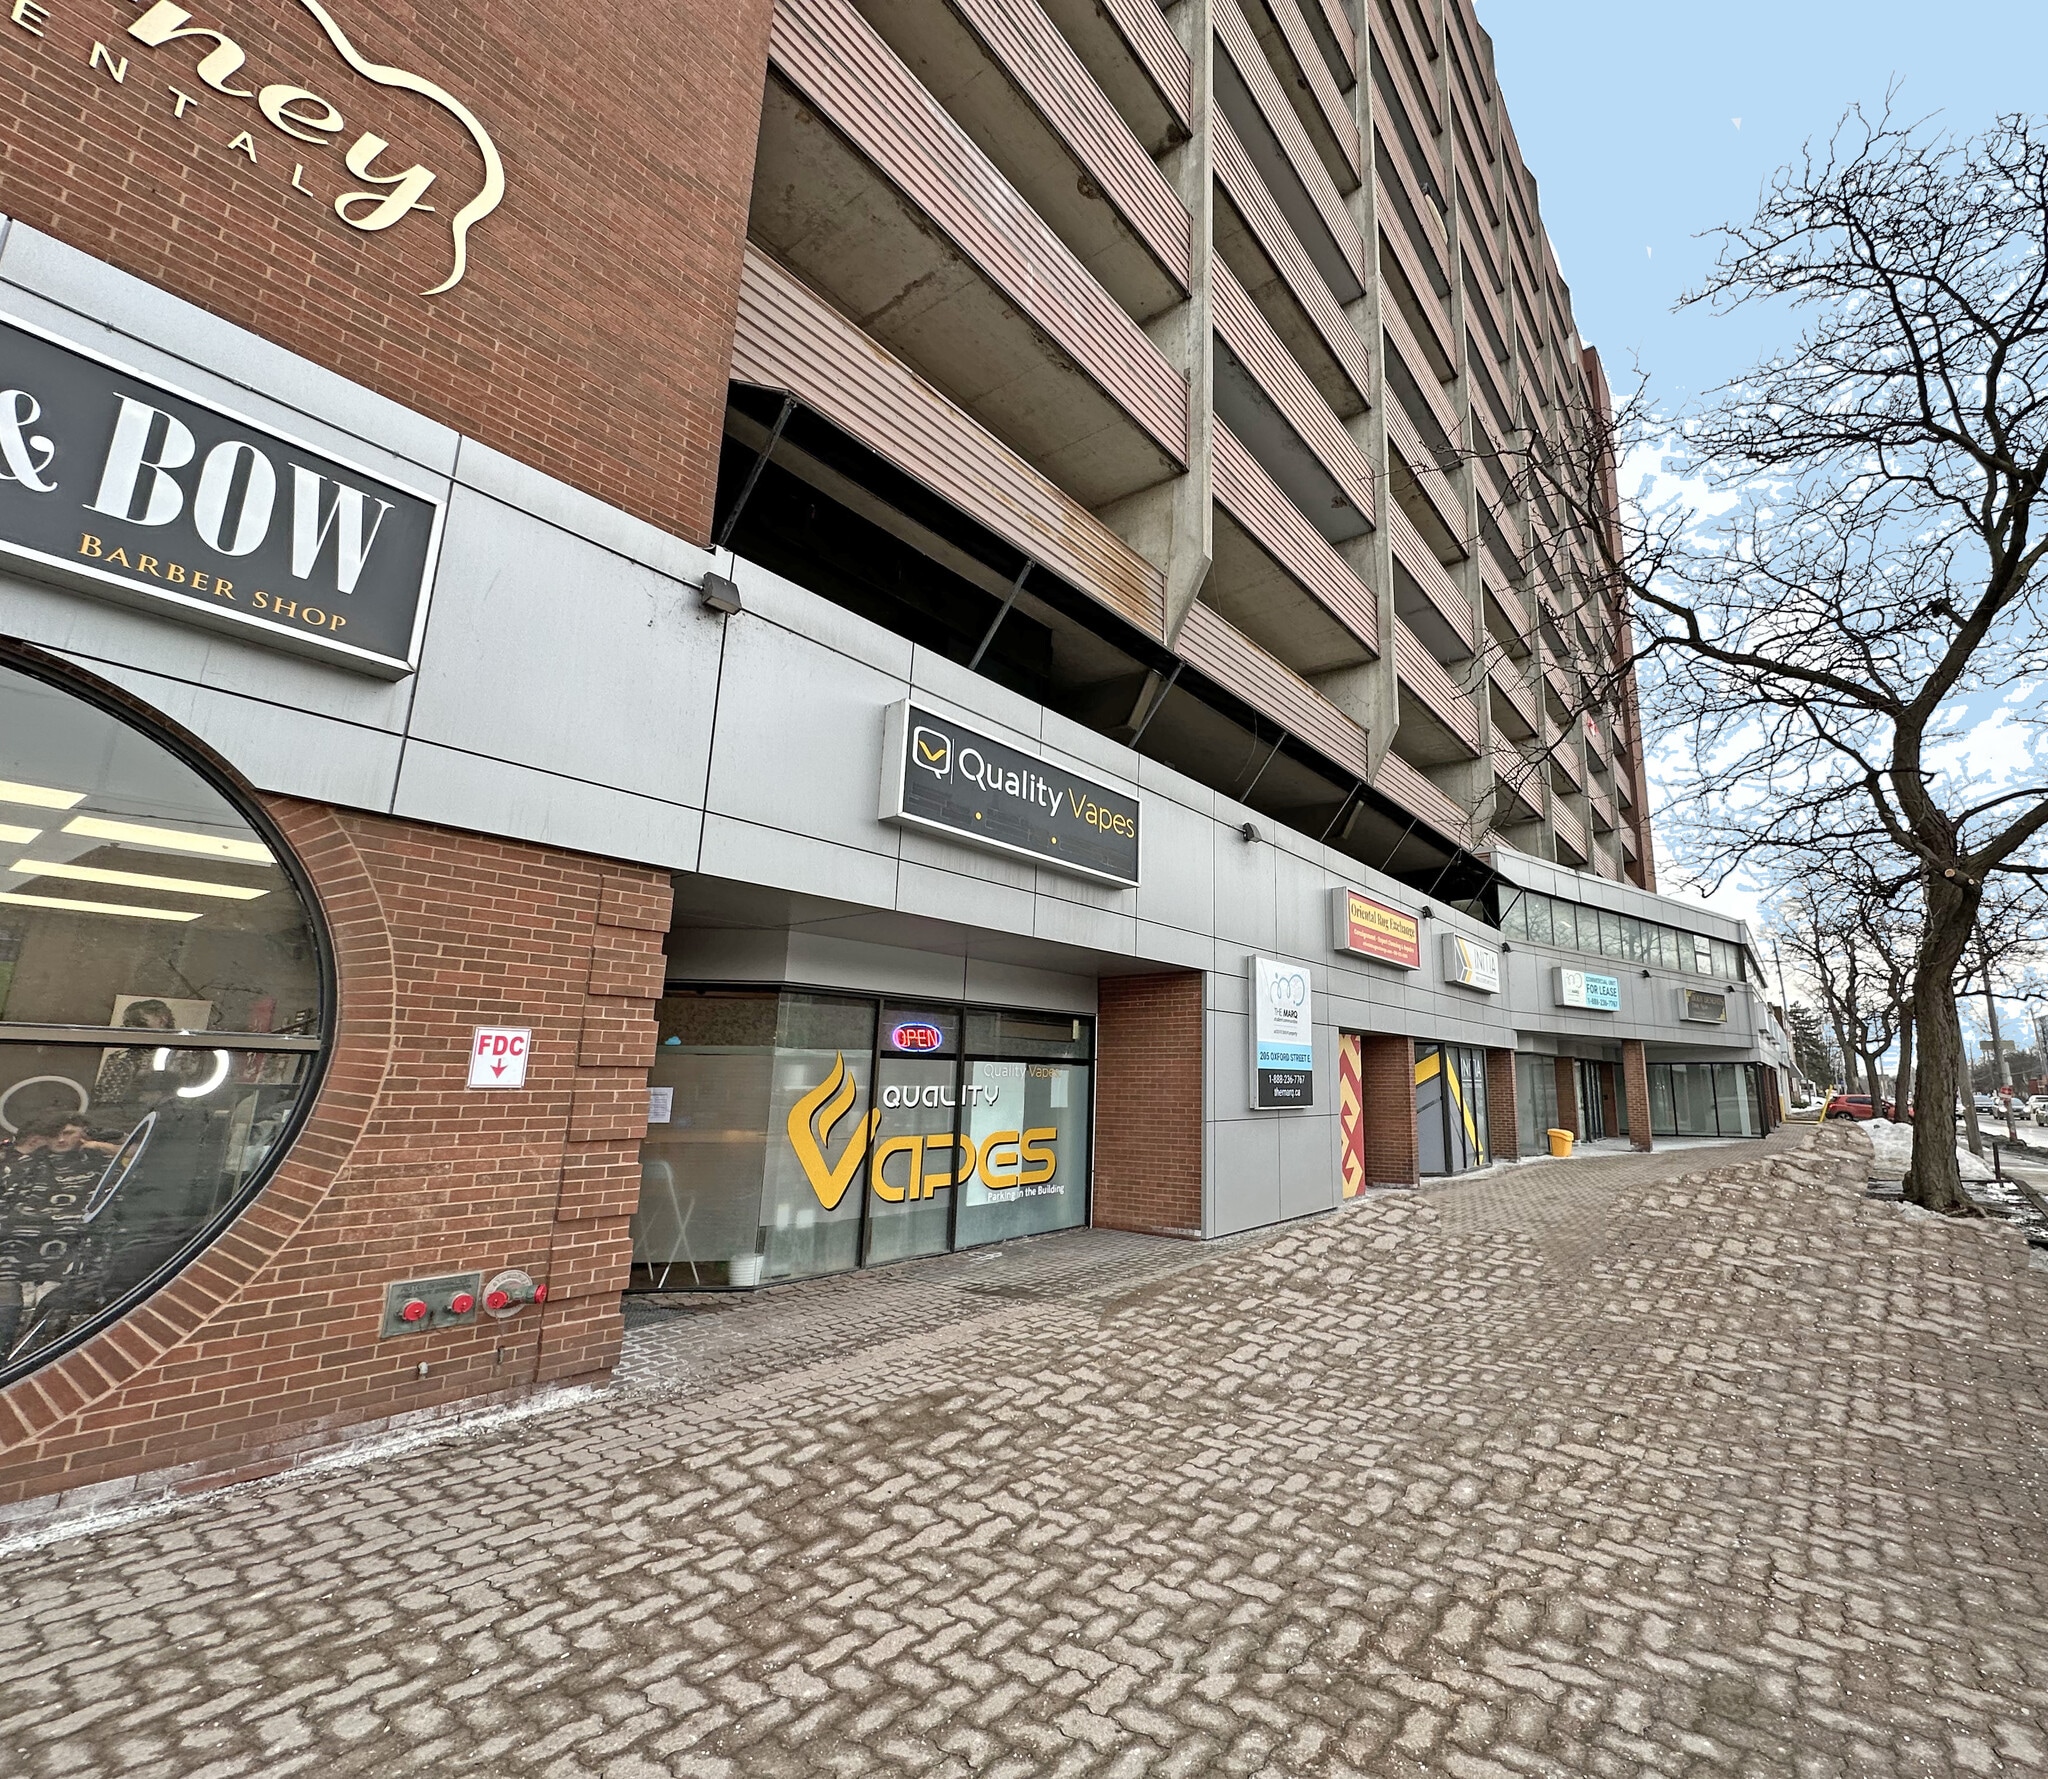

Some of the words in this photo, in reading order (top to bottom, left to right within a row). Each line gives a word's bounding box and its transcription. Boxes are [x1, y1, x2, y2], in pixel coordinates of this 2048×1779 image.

[0, 389, 58, 492] &
[82, 391, 396, 594] BOW
[78, 532, 236, 601] BARBER
[251, 591, 347, 632] SHOP
[958, 748, 1063, 817] Quality
[1068, 788, 1135, 839] Vapes
[1351, 903, 1376, 924] Oriental
[1378, 913, 1389, 931] Rug
[1389, 918, 1415, 939] Exchange
[1586, 983, 1599, 995] FOR
[1599, 986, 1618, 998] LEASE
[1283, 1009, 1298, 1019] MARQ
[477, 1034, 525, 1057] FDC
[896, 1029, 938, 1048] OPEN
[1270, 1052, 1290, 1062] OXFORD
[1290, 1053, 1307, 1063] STREET
[983, 1063, 1027, 1080] Quality
[882, 1084, 1000, 1109] QUALITY
[987, 1190, 1016, 1202] Parking
[1024, 1186, 1037, 1197] the
[1037, 1184, 1065, 1195] Building
